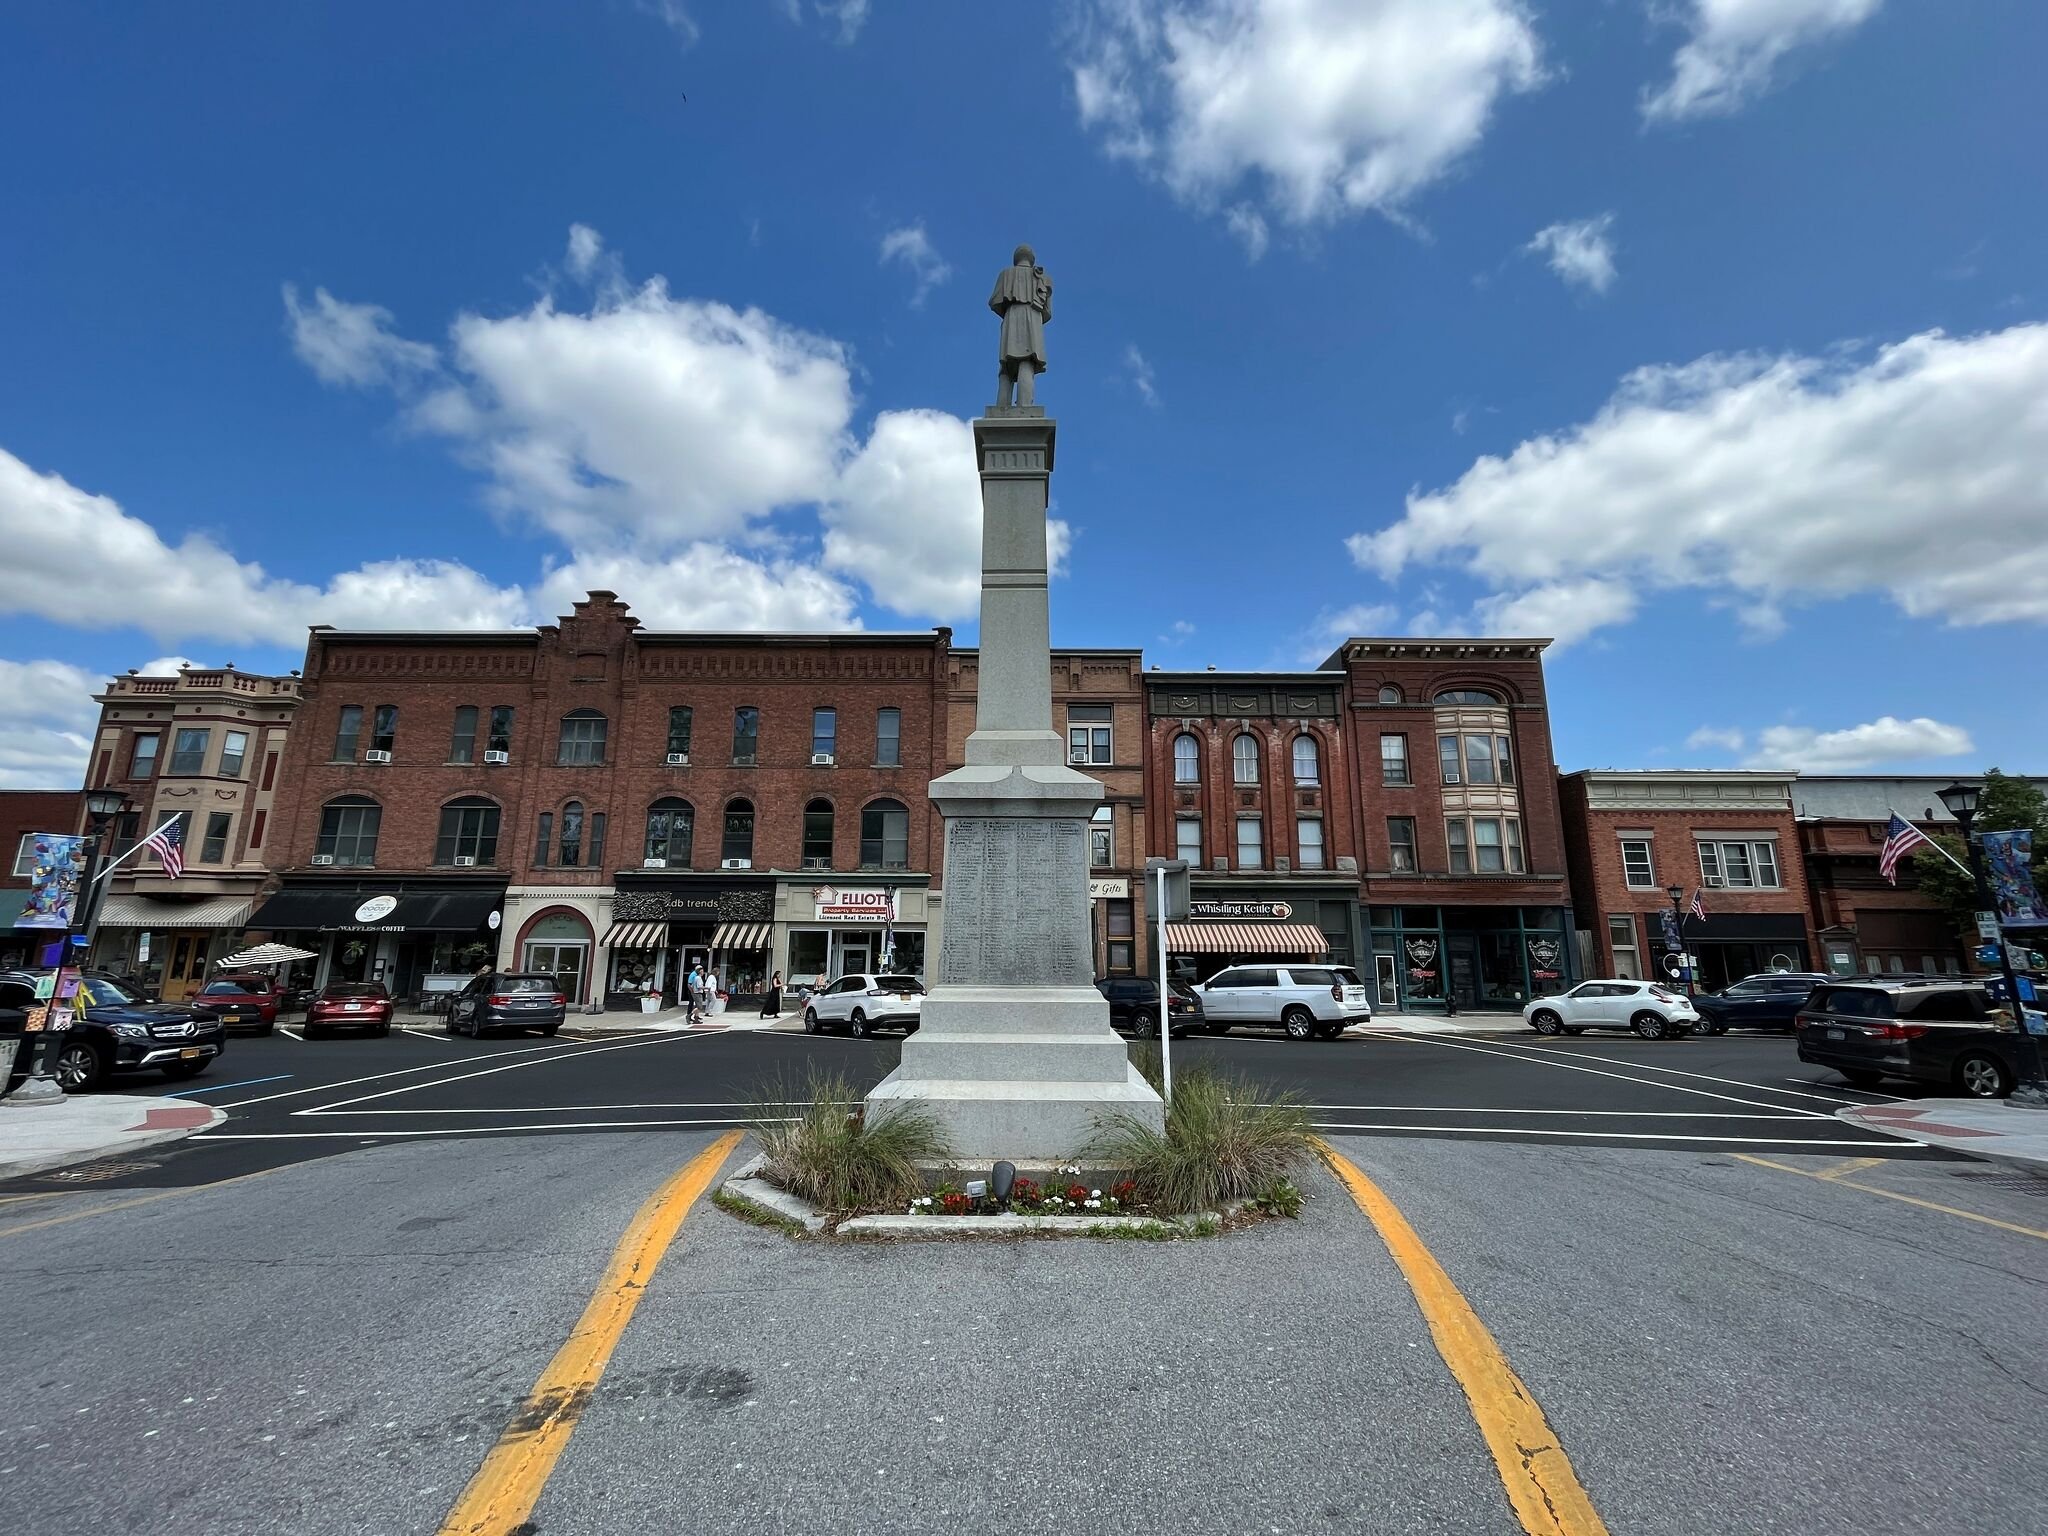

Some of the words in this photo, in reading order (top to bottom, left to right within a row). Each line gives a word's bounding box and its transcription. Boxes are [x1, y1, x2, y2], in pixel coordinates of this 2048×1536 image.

[1102, 884, 1122, 895] Gifts
[671, 899, 684, 907] db
[687, 899, 719, 908] trends
[1197, 904, 1242, 915] Whistling
[1243, 904, 1271, 913] Kettle
